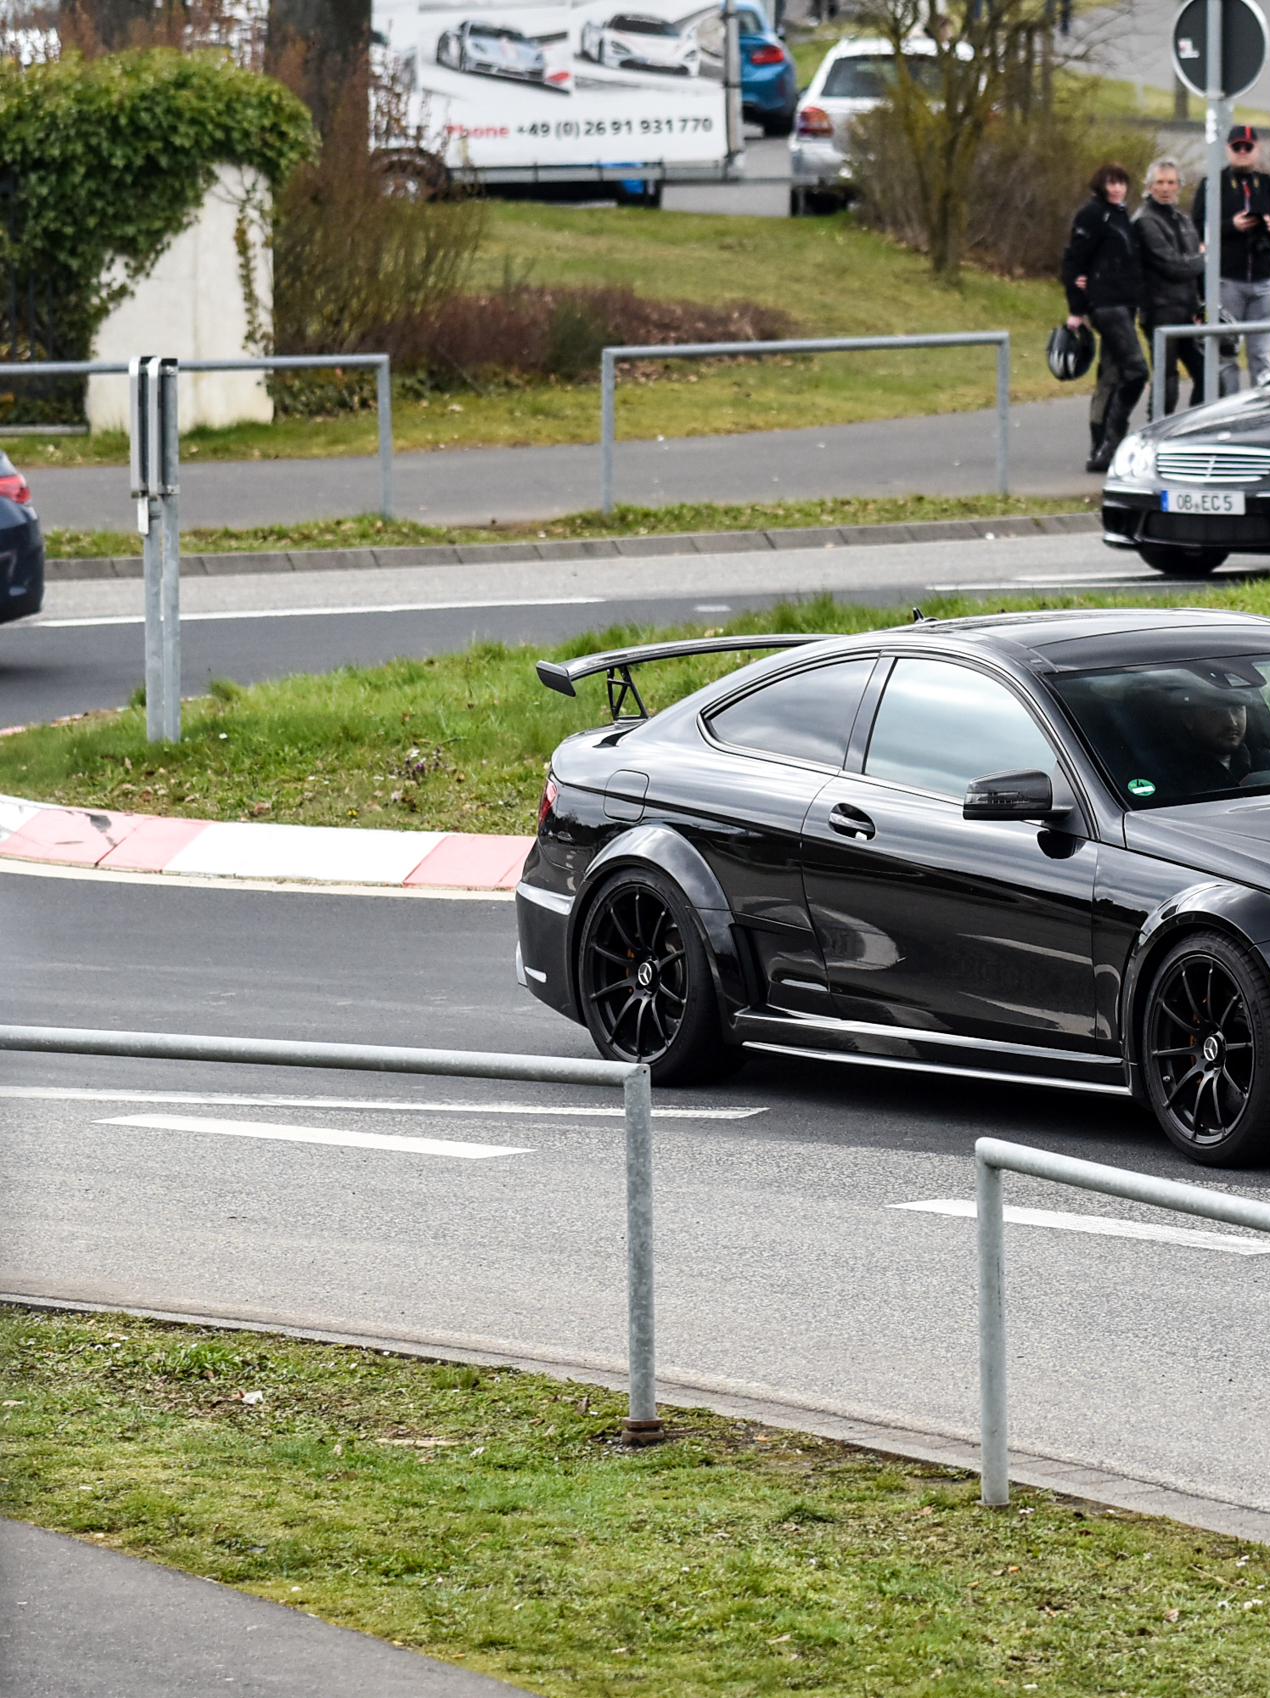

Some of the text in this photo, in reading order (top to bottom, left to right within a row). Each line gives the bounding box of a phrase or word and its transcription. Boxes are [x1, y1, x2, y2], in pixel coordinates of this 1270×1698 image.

[445, 117, 713, 139] Phone +49 (0) 26 91 931 770
[1176, 494, 1193, 511] OB
